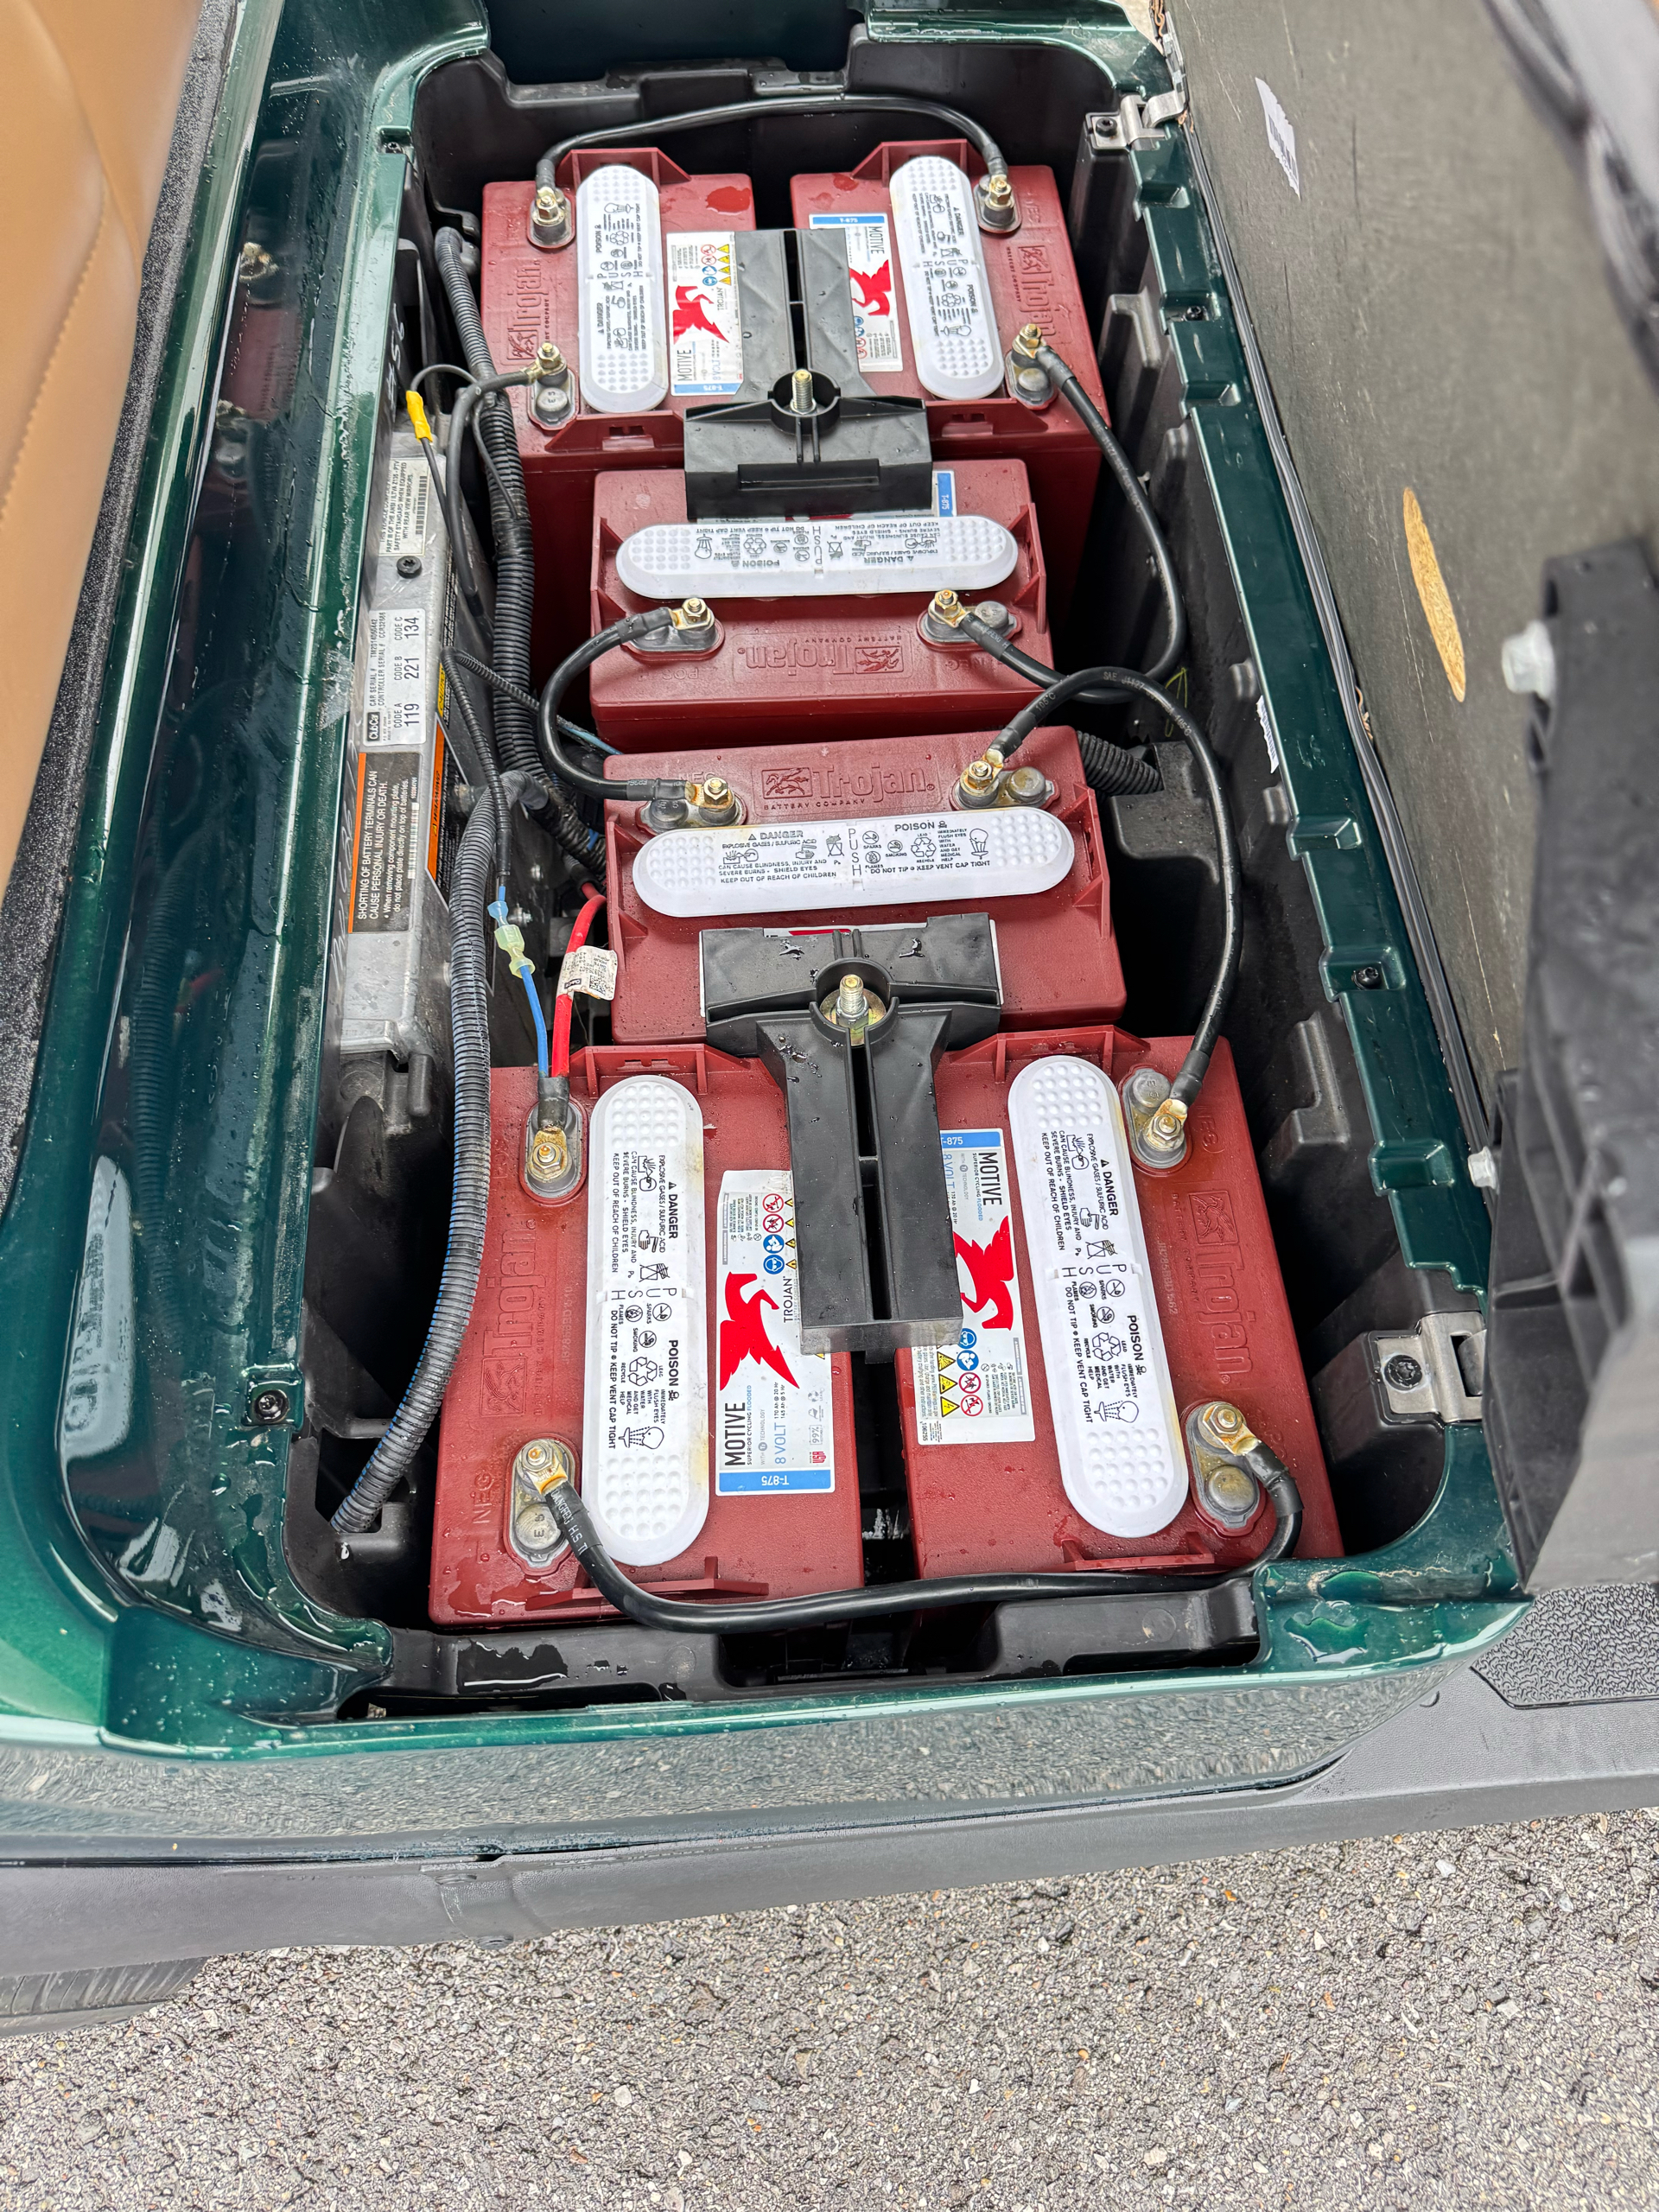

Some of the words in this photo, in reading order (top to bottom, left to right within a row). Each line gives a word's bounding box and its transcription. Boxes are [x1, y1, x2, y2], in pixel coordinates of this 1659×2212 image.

[868, 226, 884, 254] MOTIVE
[507, 264, 549, 330] Trojan
[968, 284, 976, 307] POISON
[677, 350, 692, 381] MOTIVE
[404, 617, 419, 639] 134
[745, 633, 854, 677] Trojan
[404, 658, 419, 679] 221
[1103, 672, 1117, 681] SAE
[404, 703, 419, 727] 119
[367, 771, 377, 786] CAN
[813, 765, 925, 802] Trojan
[378, 781, 387, 806] DEATH.
[400, 779, 409, 805] batteries.
[365, 788, 376, 830] TERMINALS
[377, 808, 385, 820] OR
[390, 801, 398, 828] mounting
[764, 802, 810, 810] BATTERY
[817, 798, 866, 808] COMPANY
[375, 822, 385, 848] INJURY
[760, 830, 804, 840] DANGER
[894, 821, 935, 831] POISON
[361, 832, 372, 864] BATTERY
[388, 830, 397, 863] component
[397, 835, 406, 855] directly
[360, 867, 370, 878] OF
[372, 849, 383, 891] PERSONAL
[395, 857, 404, 873] plate
[385, 865, 395, 893] removing
[394, 874, 403, 891] place
[359, 880, 369, 919] SHORTING
[371, 893, 379, 919] CAUSE
[940, 1137, 963, 1146] -875
[978, 1152, 1001, 1205] MOTIVE
[1046, 1167, 1054, 1177] OF
[612, 1187, 619, 1198] OF
[1048, 1179, 1057, 1202] REACH
[1103, 1172, 1118, 1216] DANGER
[668, 1194, 677, 1239] DANGER
[1052, 1204, 1059, 1213] OF
[612, 1226, 619, 1236] OF
[1053, 1215, 1065, 1251] CHILDREN
[1062, 1264, 1127, 1278] PUSH
[482, 1230, 546, 1355] Trojan
[611, 1288, 677, 1300] PUSH
[783, 1279, 792, 1323] TROJAN
[1065, 1287, 1072, 1298] DO
[611, 1310, 618, 1322] DO
[1194, 1244, 1256, 1374] Trojan
[1072, 1338, 1082, 1357] KEEP
[1127, 1315, 1143, 1361] POISON
[668, 1340, 678, 1386] POISON
[1076, 1360, 1084, 1380] VENT
[1079, 1382, 1088, 1398] CAP
[1082, 1400, 1092, 1423] TIGHT
[724, 1402, 746, 1466] MOTIVE
[773, 1422, 786, 1454] VOLT
[811, 1427, 820, 1444] 99%
[811, 1452, 826, 1464] USA
[761, 1475, 789, 1485] T-875
[472, 1471, 492, 1523] NEG
